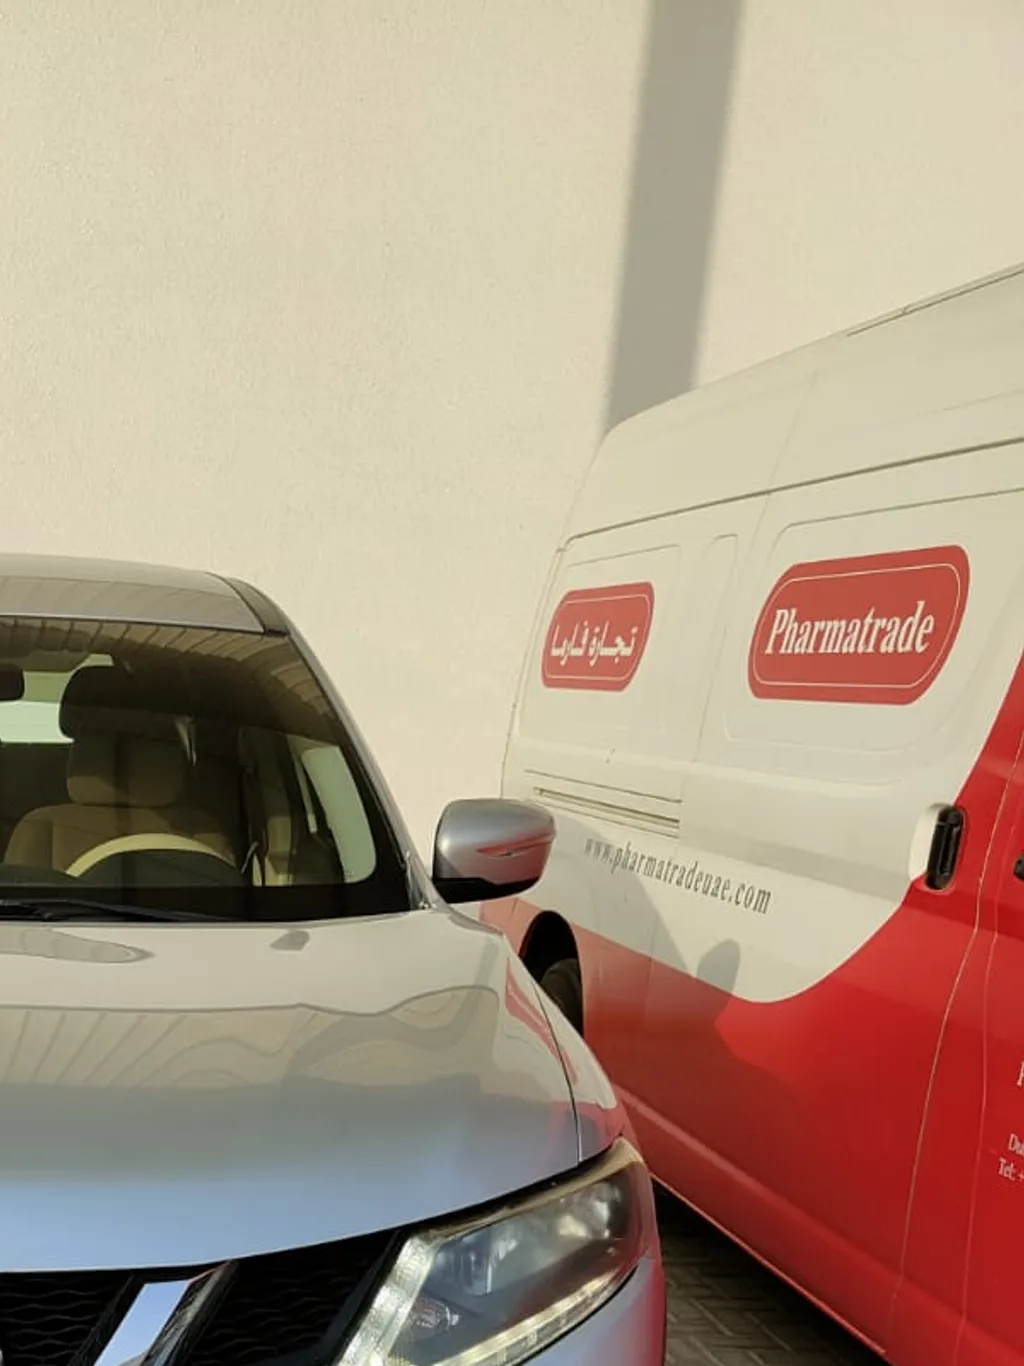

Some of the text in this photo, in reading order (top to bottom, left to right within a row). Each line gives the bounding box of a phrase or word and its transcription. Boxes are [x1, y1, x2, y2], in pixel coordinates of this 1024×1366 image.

[588, 620, 638, 667] تجارة
[765, 600, 935, 655] Pharmatrade
[584, 838, 772, 915] www.pharmatradeuae.com
